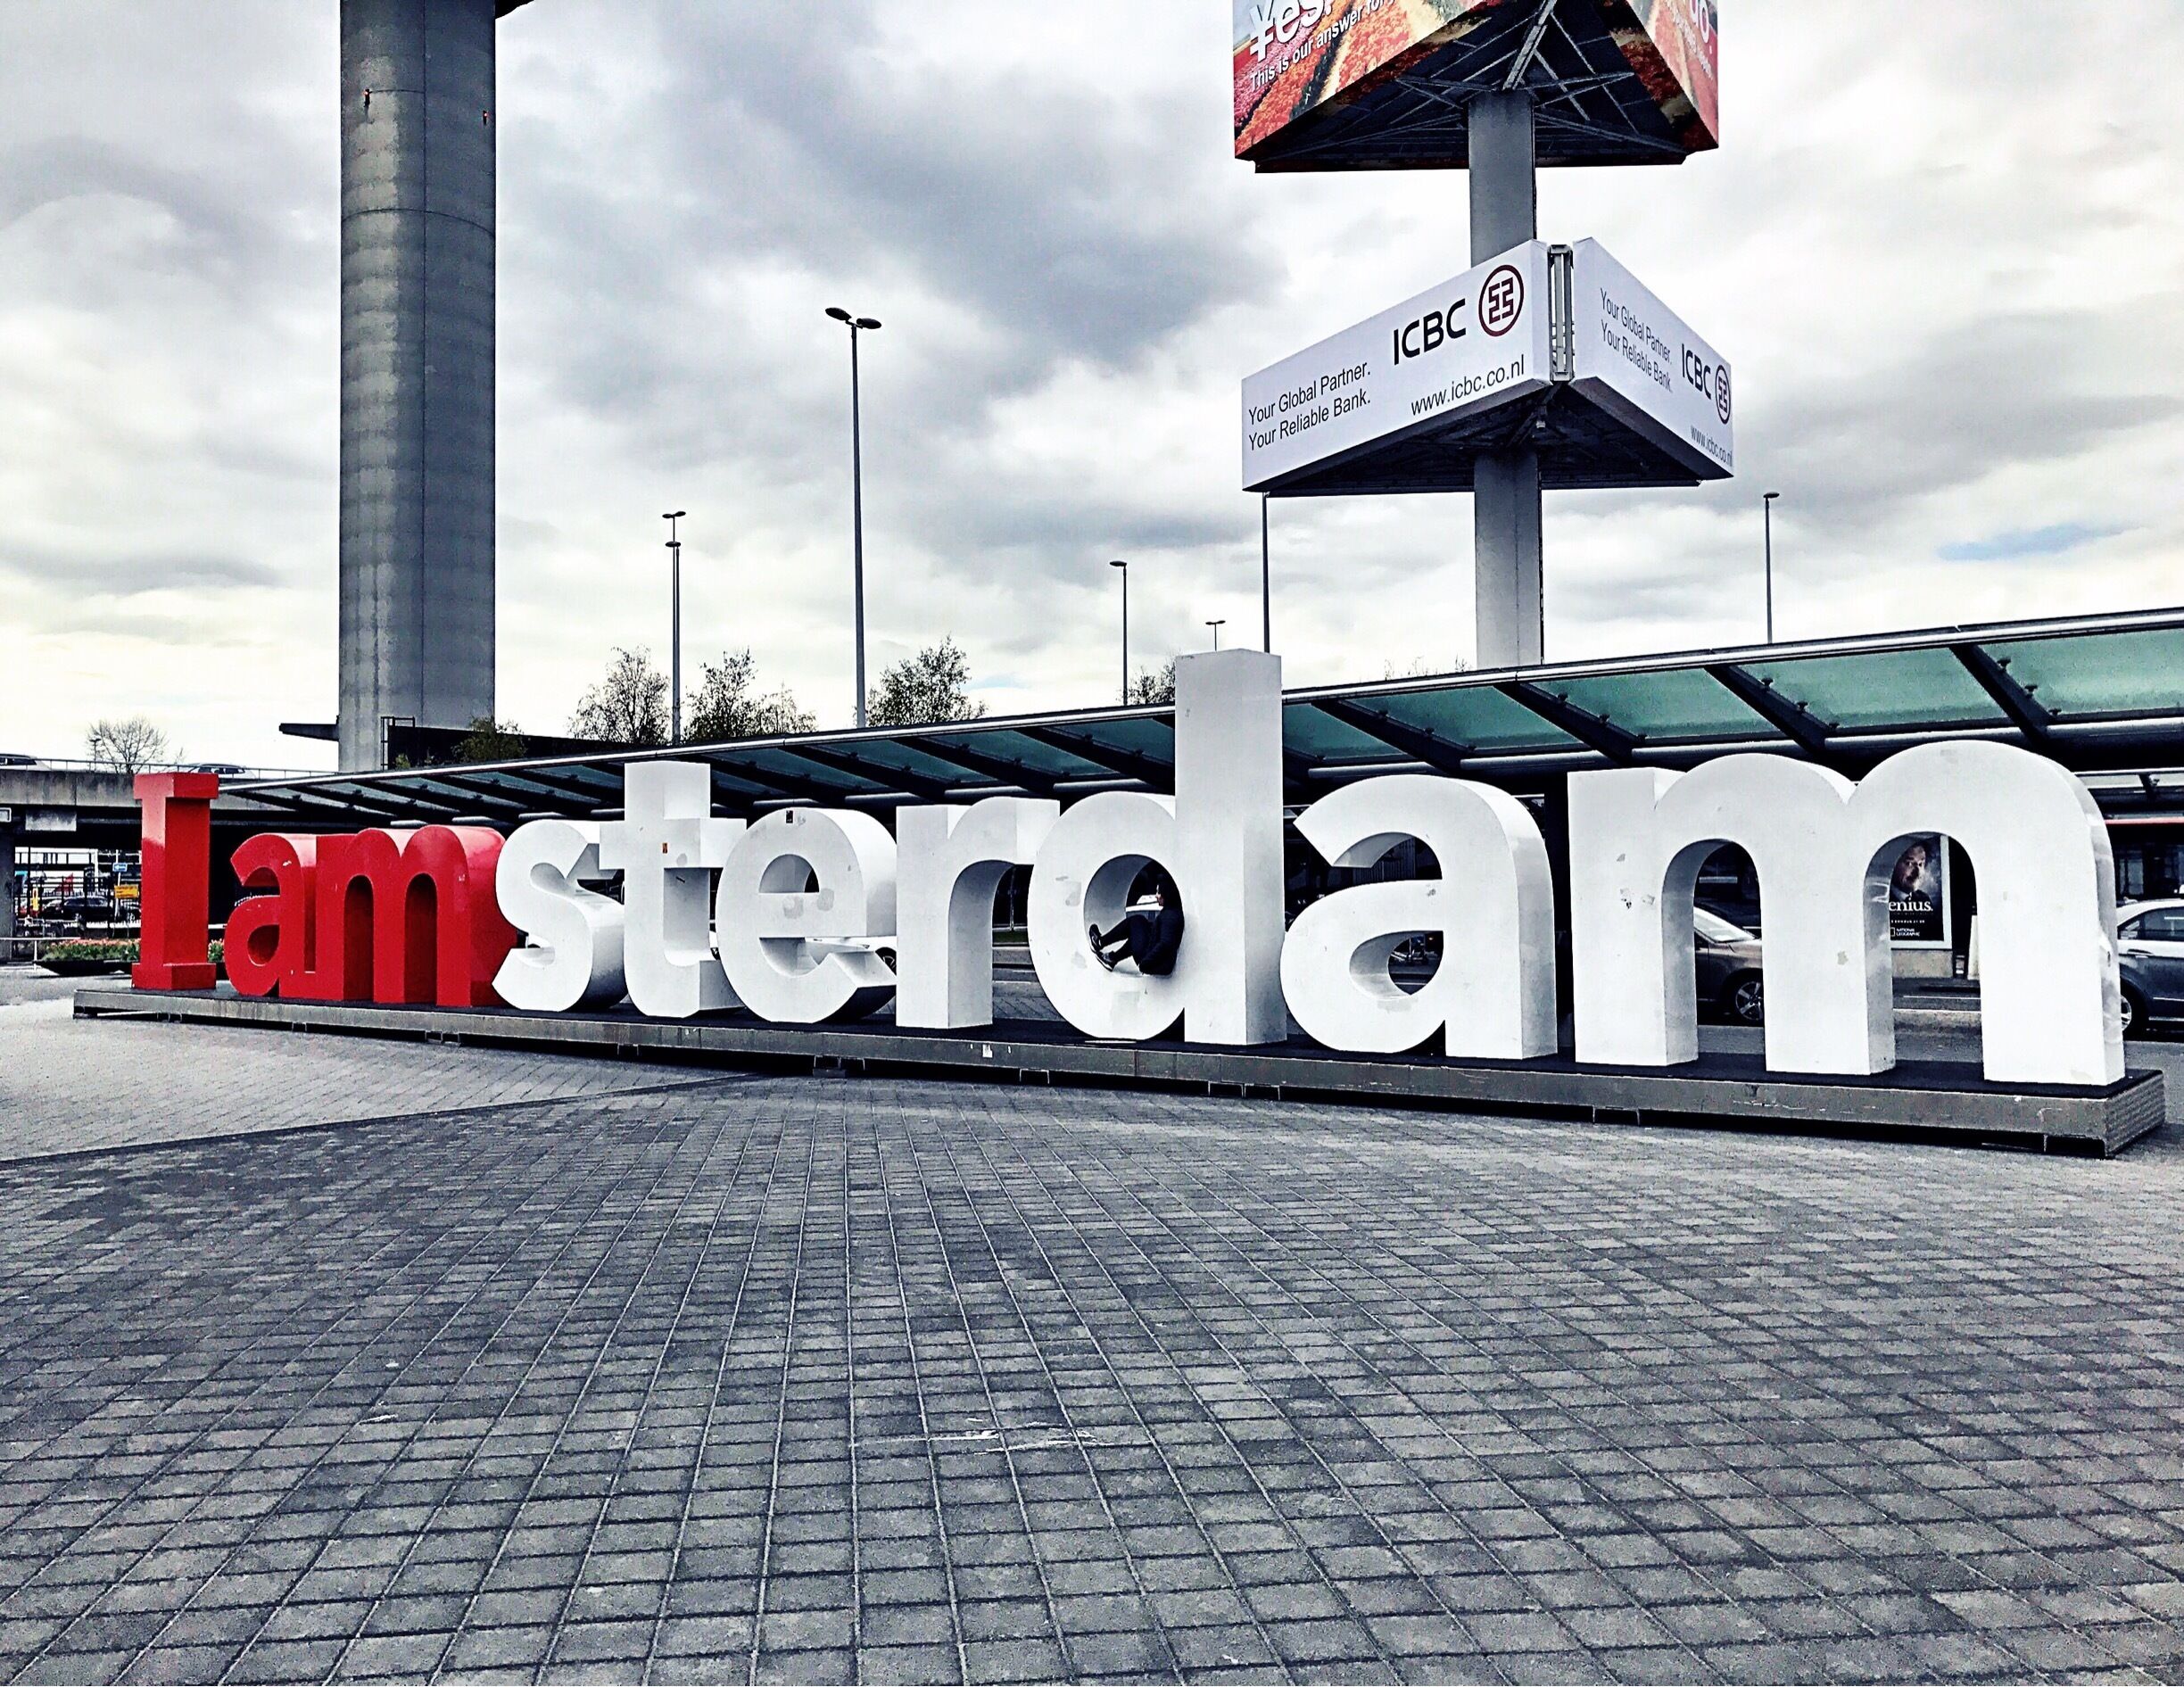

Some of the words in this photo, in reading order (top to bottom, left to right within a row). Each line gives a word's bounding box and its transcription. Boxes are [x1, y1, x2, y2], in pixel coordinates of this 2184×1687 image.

[1251, 62, 1277, 89] This
[1278, 56, 1289, 74] is
[1293, 39, 1313, 64] our
[1316, 7, 1364, 47] answer
[1394, 298, 1467, 366] ICBC
[1600, 287, 1620, 321] Your
[1620, 305, 1645, 342] Global
[1410, 353, 1526, 417] www.icbc.co.nl
[1601, 318, 1621, 352] Your
[1622, 335, 1652, 376] Reliable
[1653, 361, 1674, 393] Bank.
[1681, 343, 1712, 401] ICBC
[1248, 403, 1277, 426] Your
[1278, 380, 1318, 412] Global
[1320, 361, 1371, 396] Partner.
[1248, 428, 1277, 451] Your
[1279, 405, 1330, 440] Reliable
[1333, 387, 1371, 418] Bank.
[1691, 424, 1733, 467] www.icbc.co.nl
[1888, 897, 1933, 912] enius.
